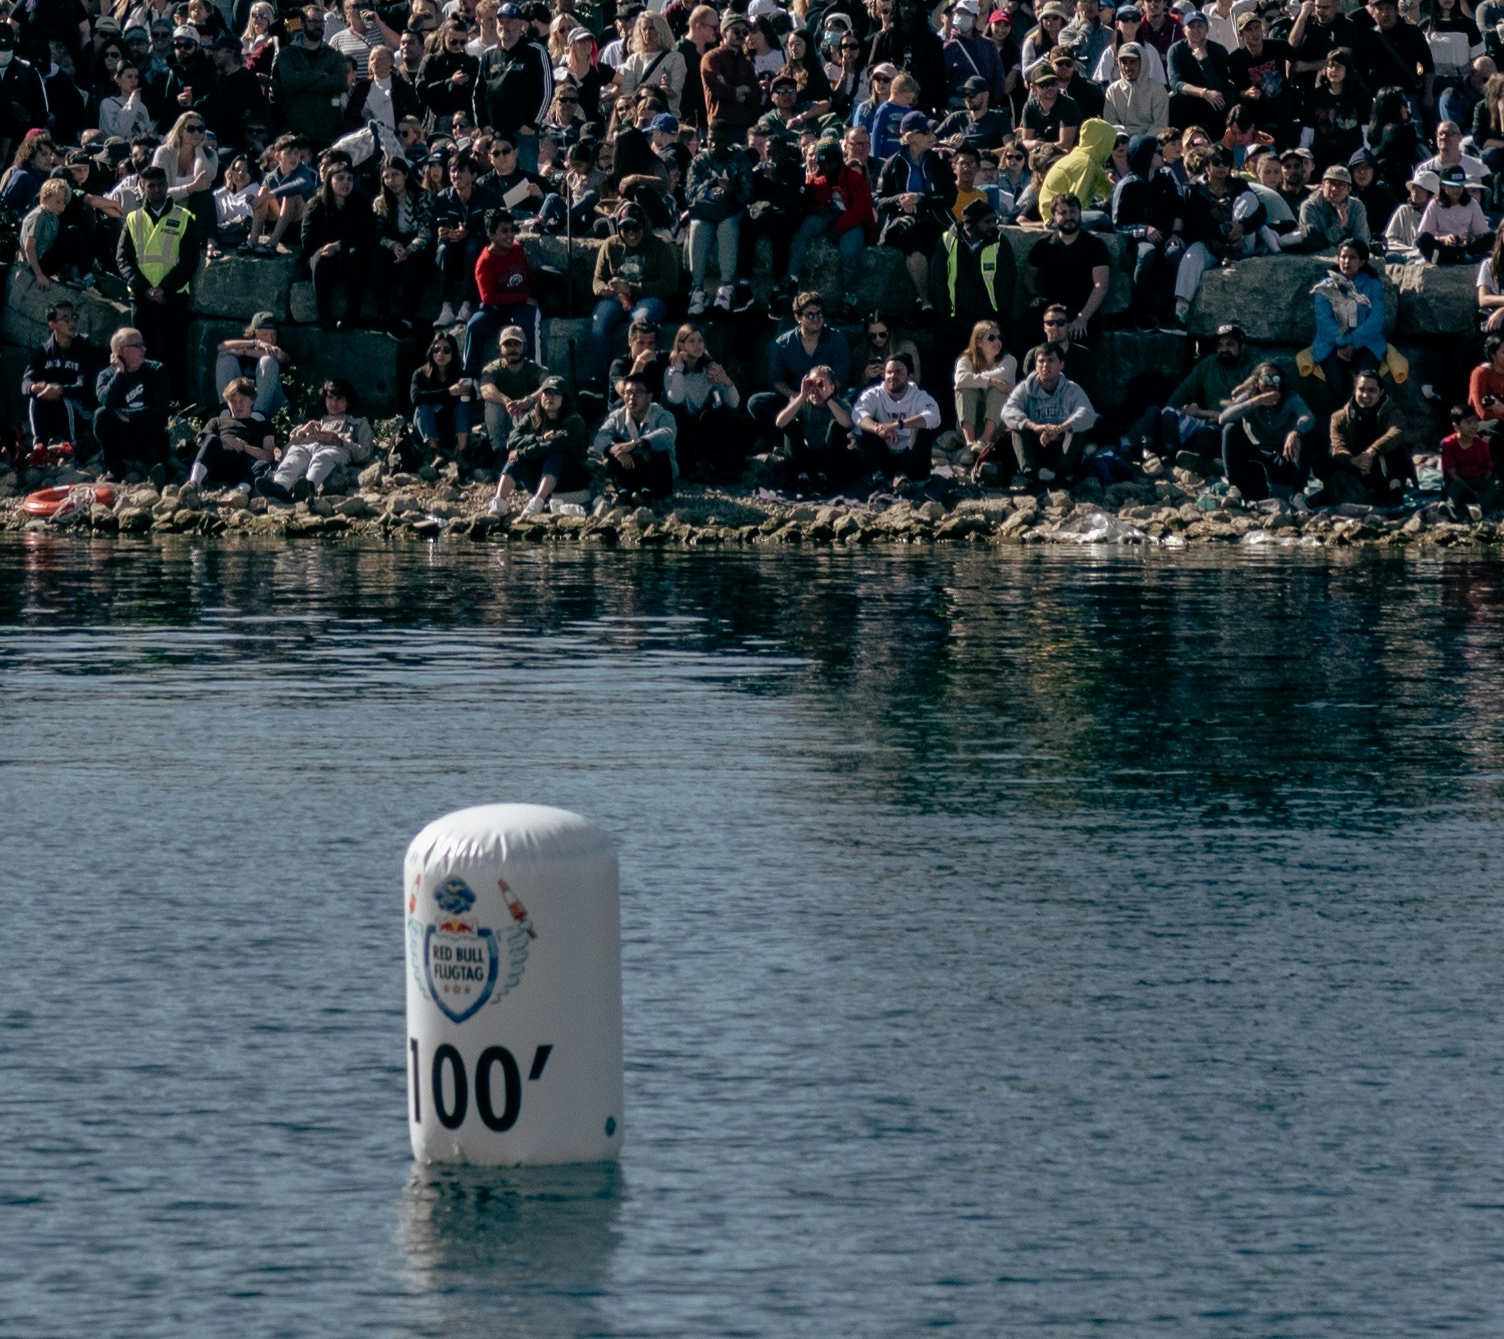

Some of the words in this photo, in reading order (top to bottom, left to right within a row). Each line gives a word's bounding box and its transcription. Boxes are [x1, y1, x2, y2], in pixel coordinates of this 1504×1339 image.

[433, 945, 452, 961] RED
[456, 946, 485, 963] BULL
[434, 963, 484, 982] FLUGTAG
